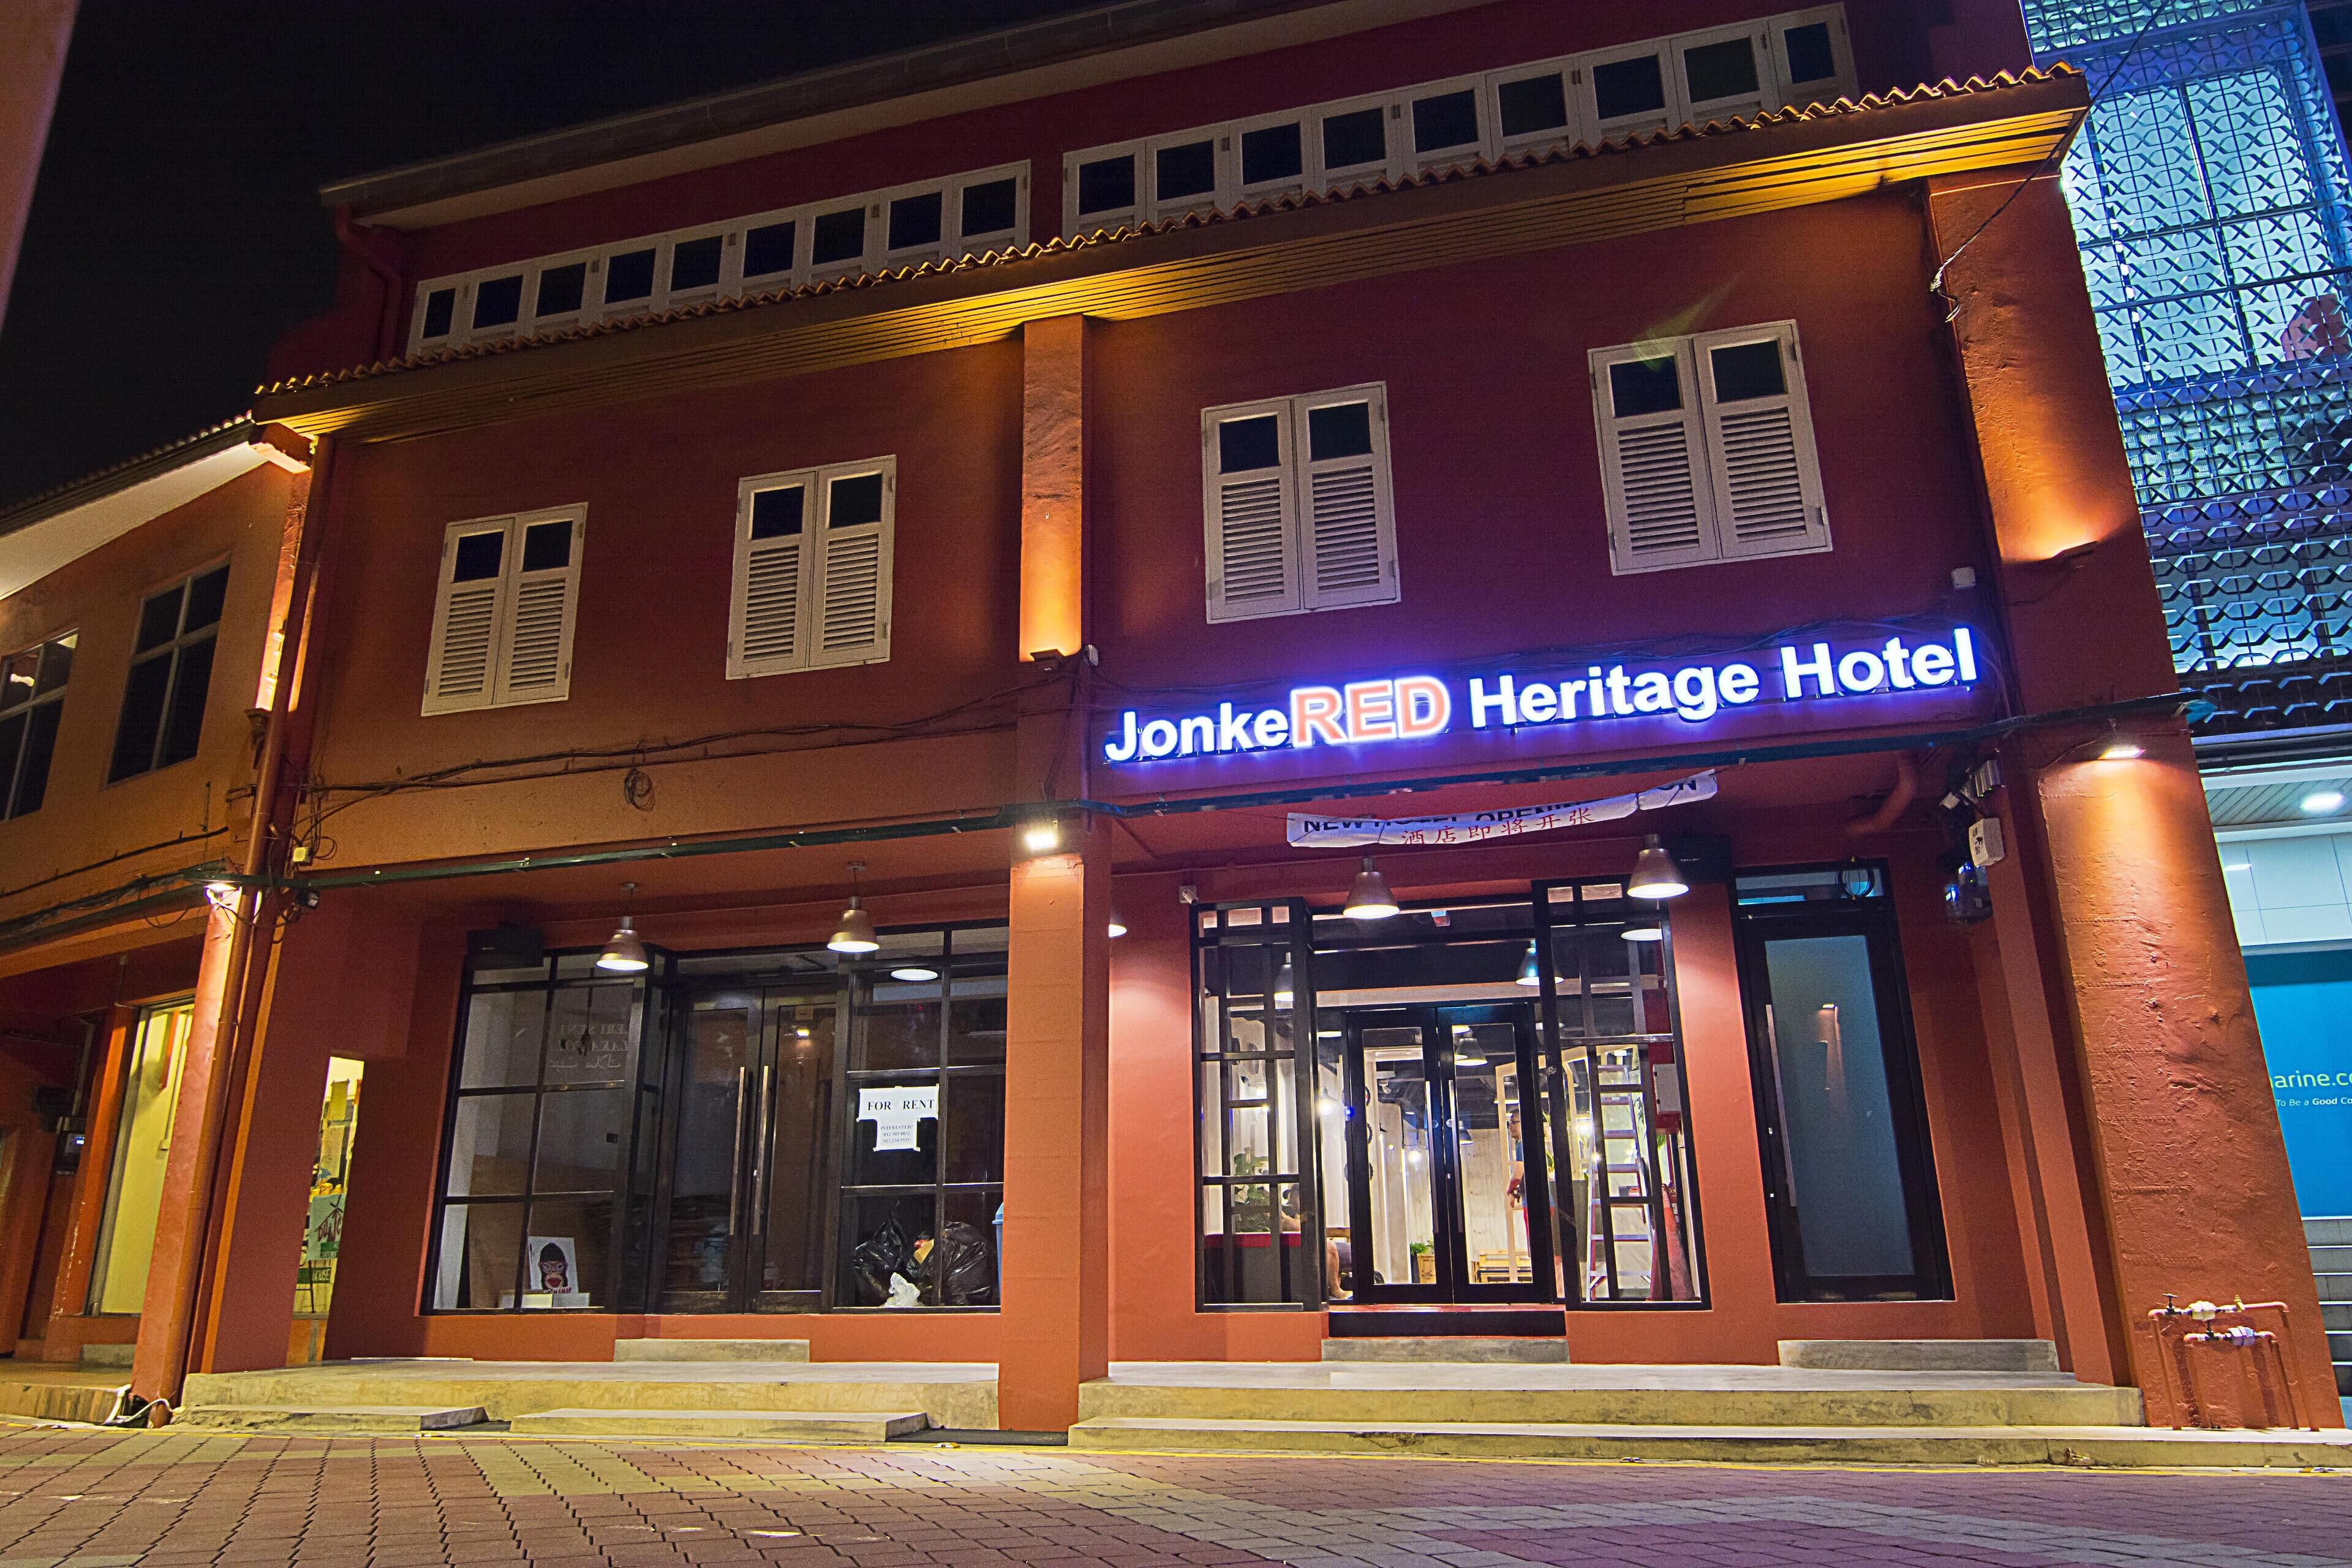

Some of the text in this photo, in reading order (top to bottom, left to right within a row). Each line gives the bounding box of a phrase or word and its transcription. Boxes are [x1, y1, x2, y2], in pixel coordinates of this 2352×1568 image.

[1105, 628, 1977, 761] JonkeRED Heritage Hotel
[1401, 807, 1596, 844] 酒店即将开张
[2270, 1070, 2352, 1088] arine.c
[868, 1099, 935, 1110] FOR RENT
